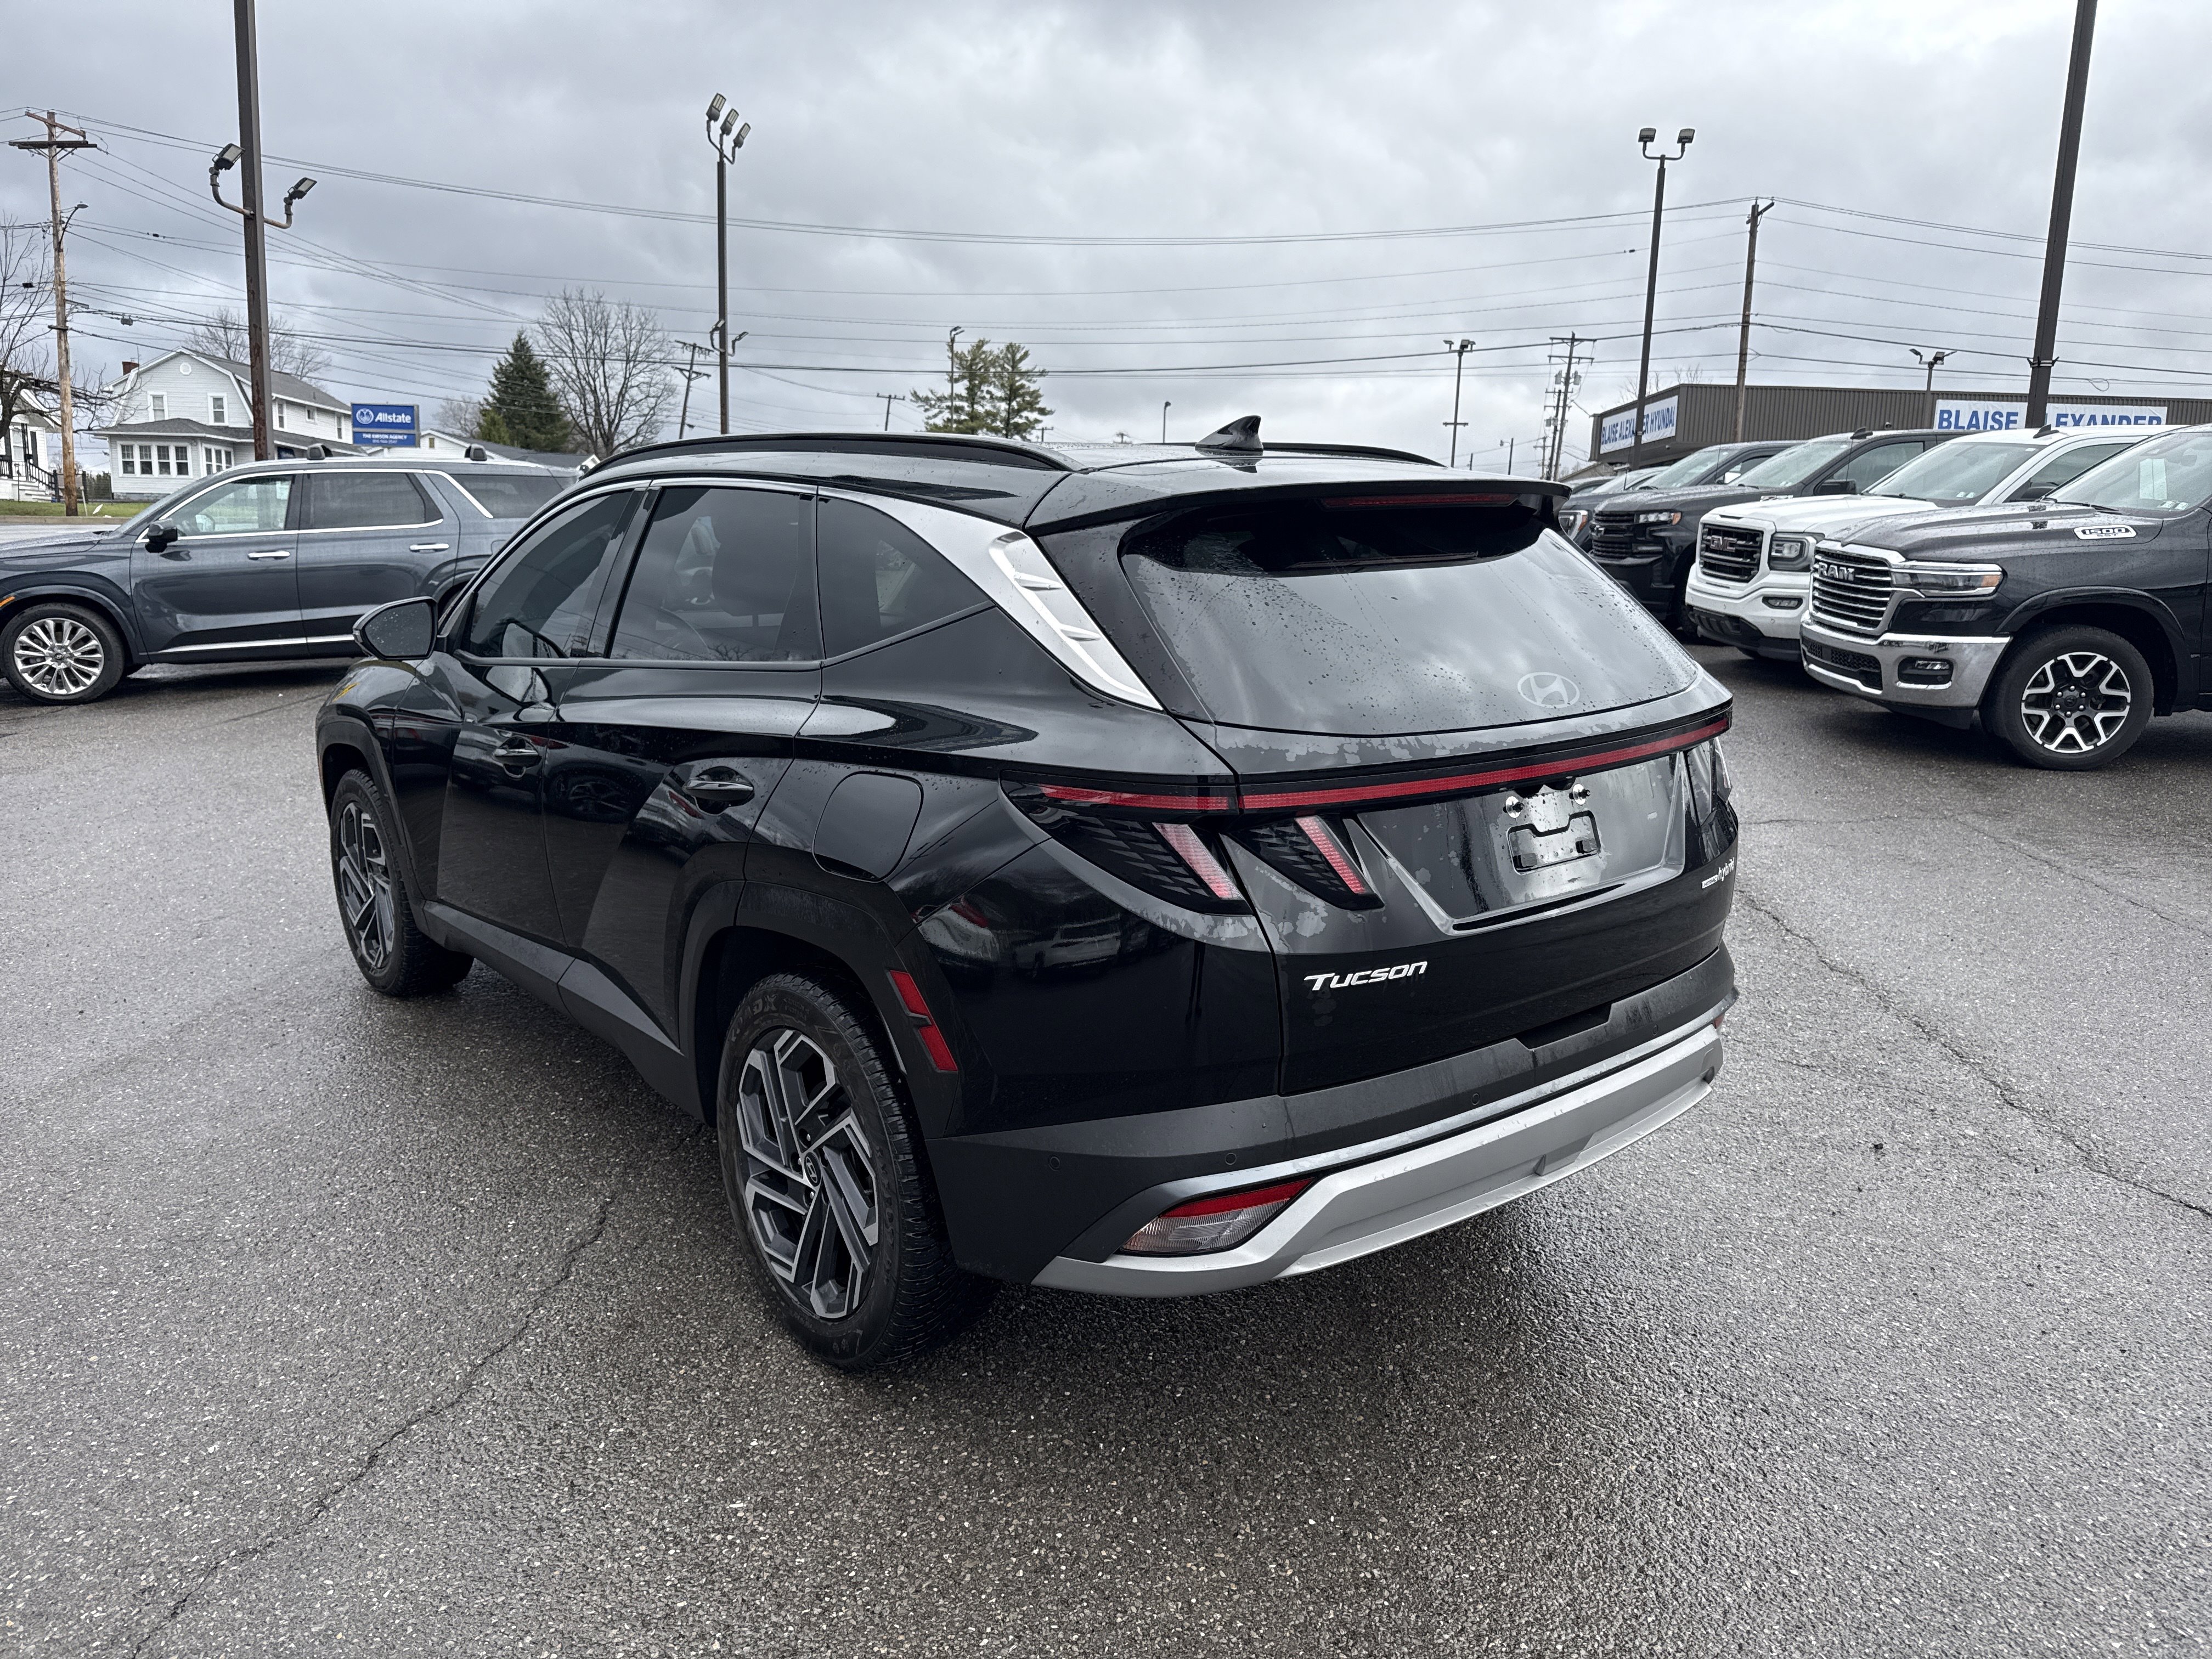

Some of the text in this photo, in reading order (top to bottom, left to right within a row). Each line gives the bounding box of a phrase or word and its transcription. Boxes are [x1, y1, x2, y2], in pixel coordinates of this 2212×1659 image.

[375, 412, 411, 424] Allstate
[1601, 405, 1675, 445] BLAISE ALEXAER HYUNDAI
[1938, 409, 2018, 430] BLAISE
[1710, 535, 1737, 552] GMC
[1818, 562, 1855, 580] RAM
[1718, 857, 1735, 882] hybrid
